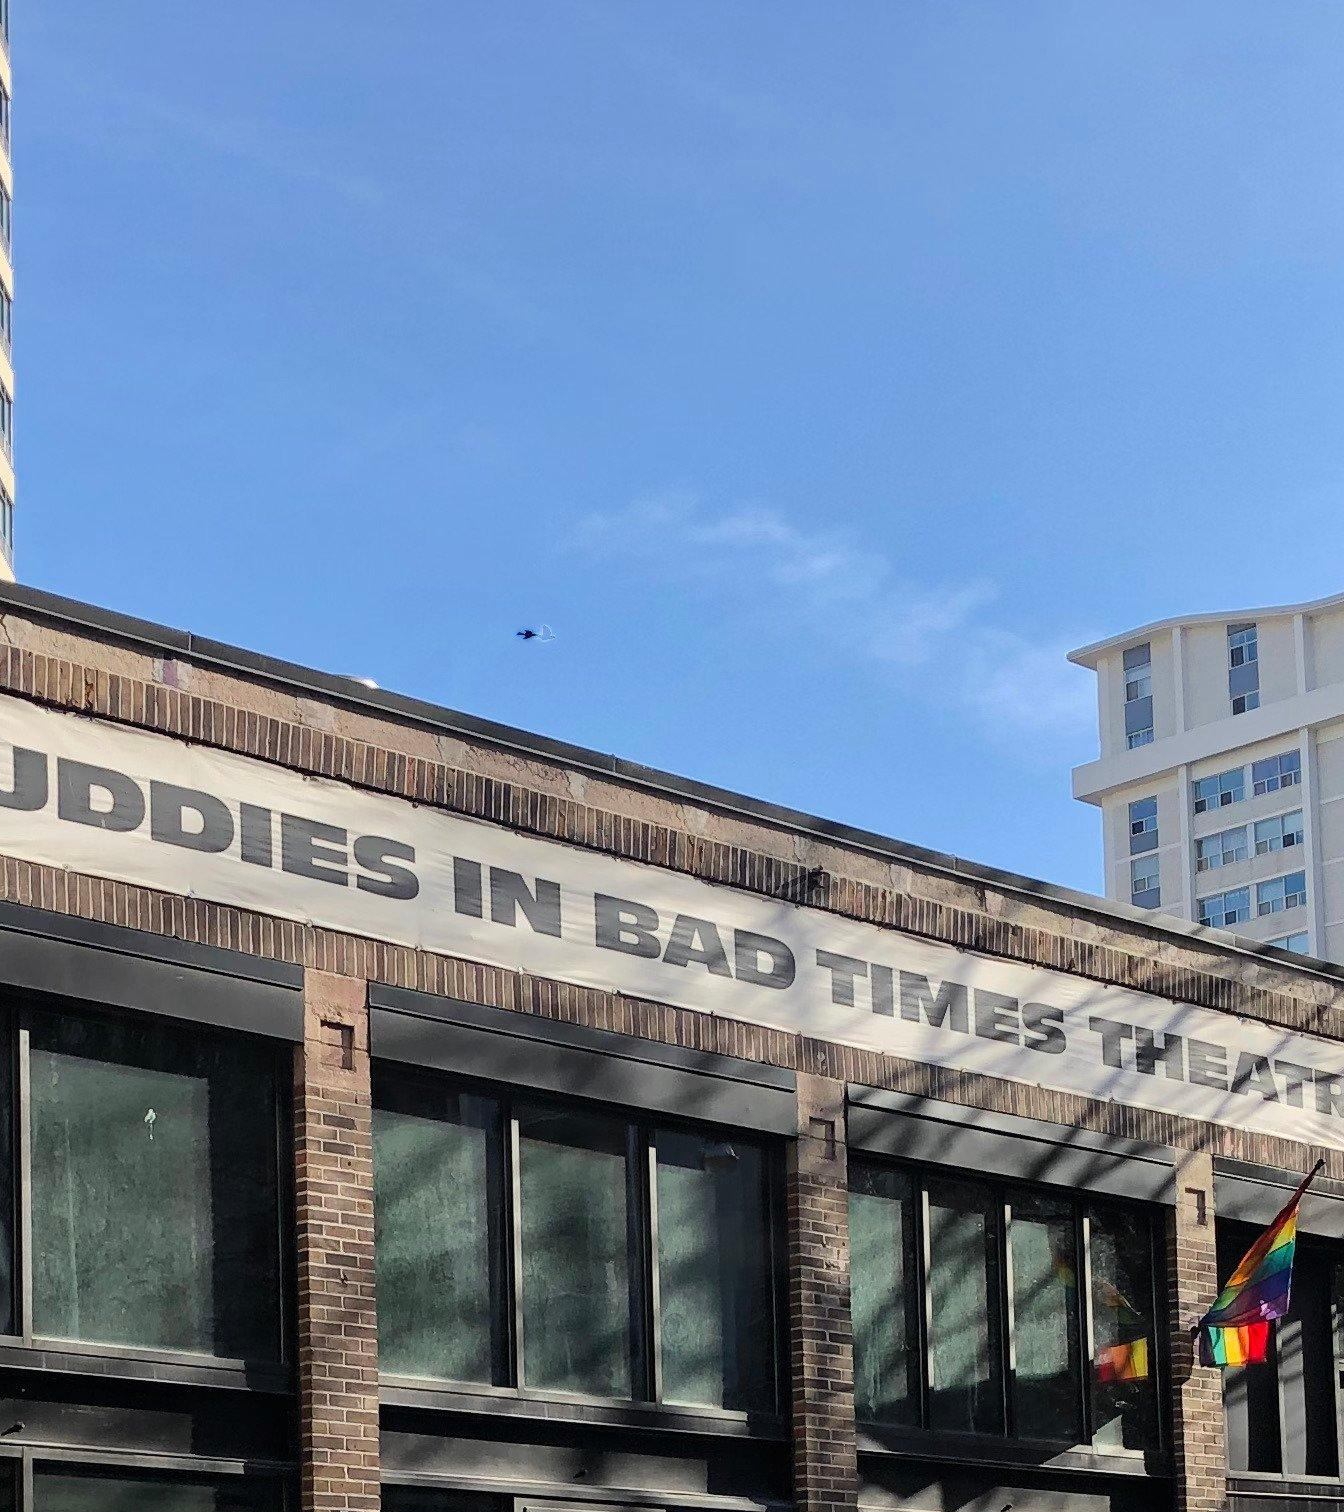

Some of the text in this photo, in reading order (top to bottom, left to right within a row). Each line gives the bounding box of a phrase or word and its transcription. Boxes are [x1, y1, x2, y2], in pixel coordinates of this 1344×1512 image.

[453, 856, 561, 938] IN
[595, 892, 795, 991] BAD
[816, 949, 1067, 1056] TIMES
